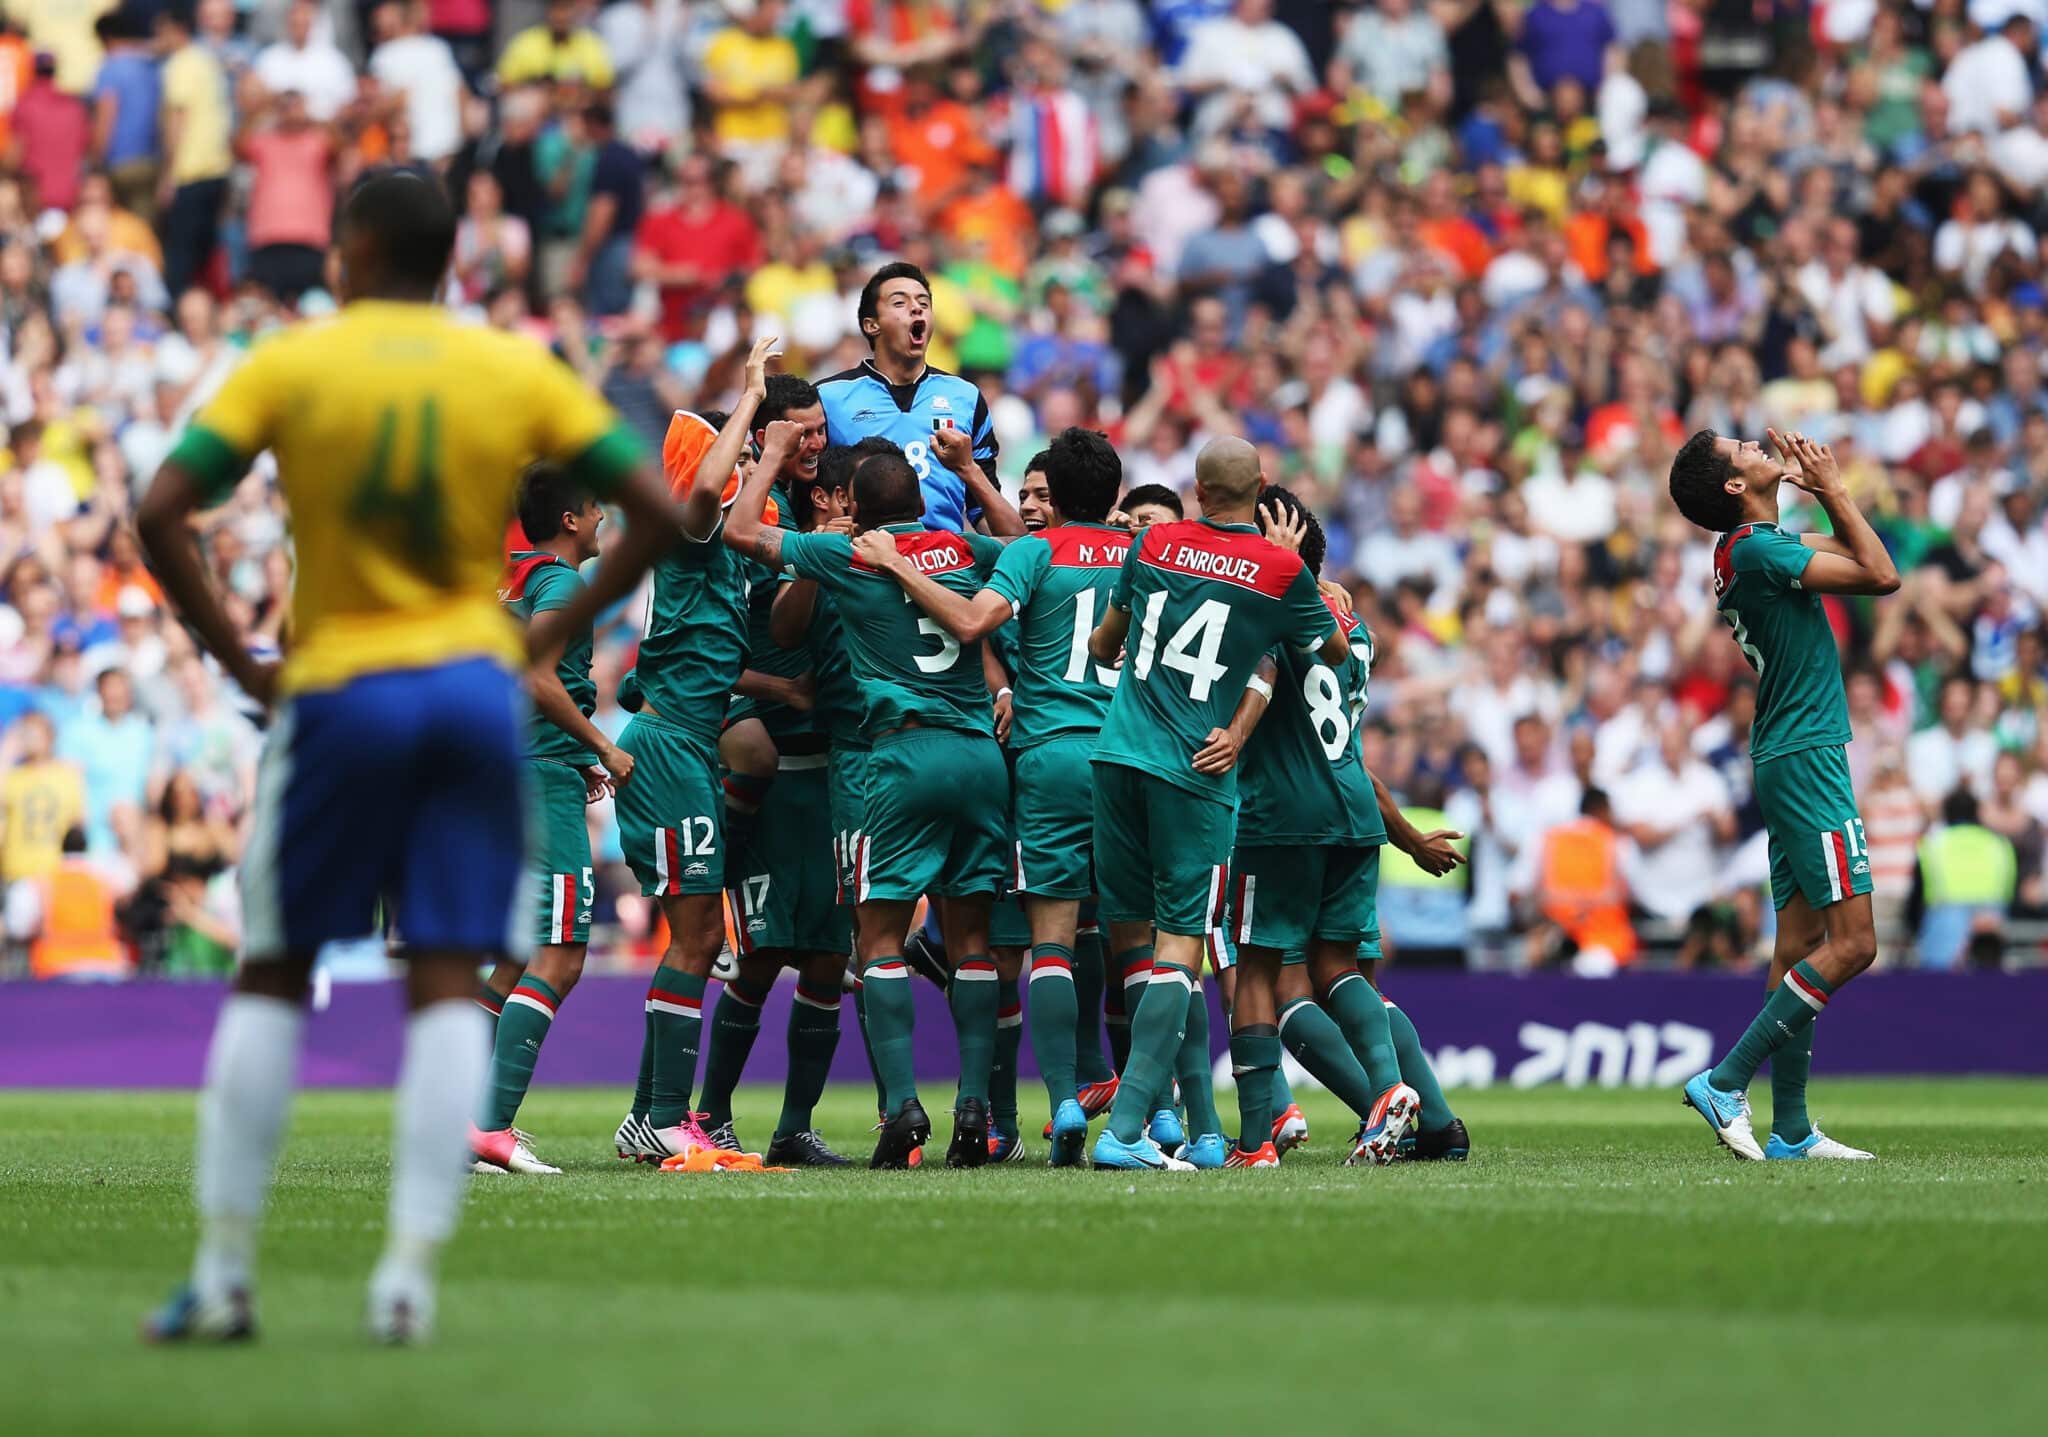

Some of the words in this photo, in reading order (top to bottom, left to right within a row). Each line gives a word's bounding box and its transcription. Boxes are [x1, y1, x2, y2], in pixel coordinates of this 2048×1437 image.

[1079, 544, 1098, 564] N.
[1159, 543, 1170, 563] J.
[1174, 546, 1261, 584] ENRIQUEZ
[1134, 590, 1231, 702] 14
[1303, 663, 1350, 761] 8
[681, 816, 716, 856] 12
[1844, 817, 1868, 857] 13
[582, 866, 595, 907] 5
[742, 873, 770, 915] 17
[1511, 1020, 1714, 1089] 2012
